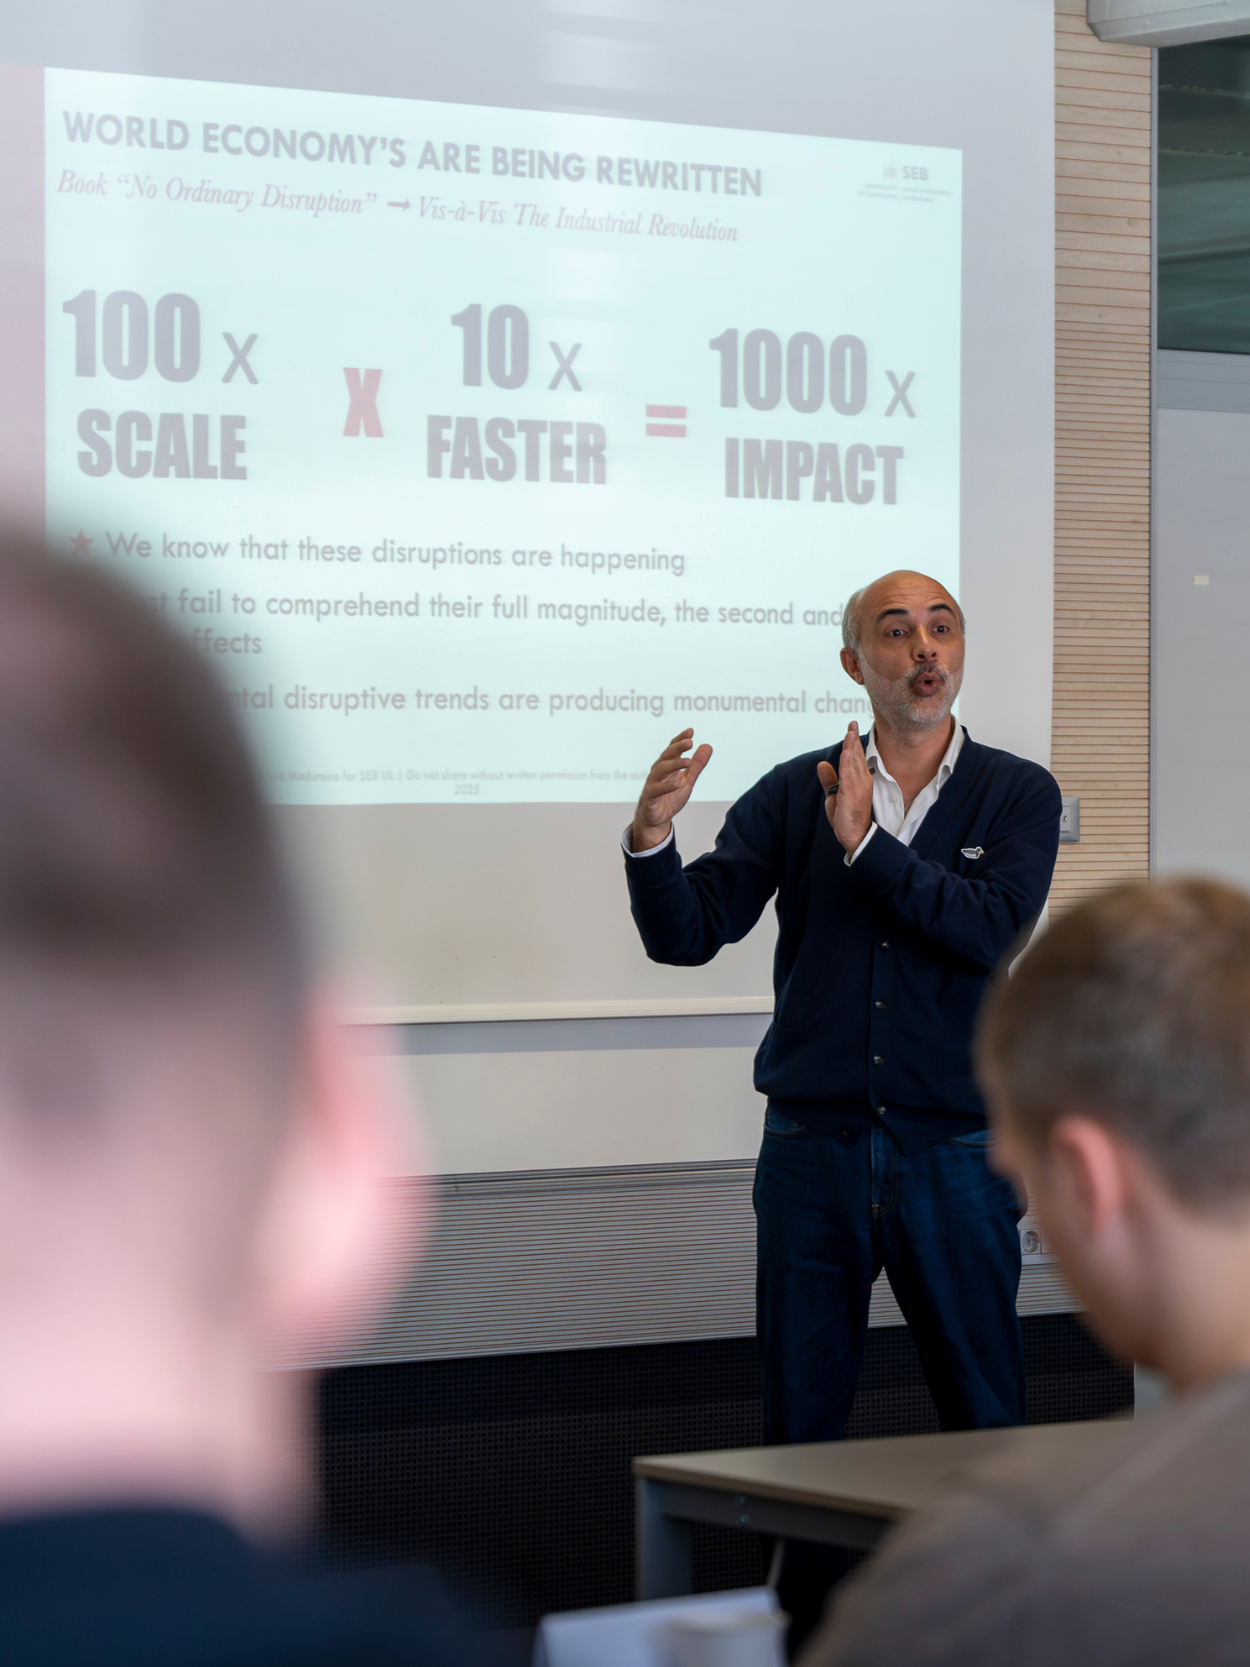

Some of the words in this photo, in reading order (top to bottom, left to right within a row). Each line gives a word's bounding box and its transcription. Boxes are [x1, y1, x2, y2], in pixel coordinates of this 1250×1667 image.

[63, 111, 190, 150] WORLD
[417, 141, 480, 174] ARE
[492, 146, 586, 182] BEING
[597, 156, 762, 197] REWRITTEN
[902, 166, 929, 181] SEB
[56, 169, 108, 196] Book
[166, 177, 254, 213] Ordinary
[419, 195, 506, 224] Vis-à-Vis
[513, 203, 549, 227] The
[554, 206, 642, 234] Industrial
[647, 214, 737, 242] Revolution
[62, 289, 201, 383] 100
[451, 304, 529, 390] 10
[709, 328, 867, 416] 1000
[77, 408, 247, 480] SCALE
[427, 415, 606, 484] FASTER
[725, 438, 904, 505] IMPACT
[106, 532, 152, 558] We
[163, 533, 229, 559] know
[239, 534, 289, 560] that
[298, 536, 362, 562] these
[372, 538, 502, 570] disruptions
[512, 550, 552, 567] are
[561, 543, 685, 577] happening
[178, 588, 221, 613] fail
[231, 593, 256, 614] to
[266, 592, 419, 622] comprehend
[429, 593, 483, 618] their
[492, 594, 527, 619] full
[538, 598, 666, 627] magnitude,
[675, 599, 710, 623] the
[718, 602, 793, 624] second
[803, 604, 844, 626] and
[193, 628, 262, 654] ffects
[284, 685, 407, 716] disruptive
[415, 686, 489, 710] trends
[499, 694, 540, 710] are
[550, 687, 664, 718] producing
[674, 690, 806, 713] monumental
[342, 769, 356, 782] for
[359, 770, 378, 782] SEB
[381, 770, 395, 781] UL
[406, 769, 421, 781] Do
[423, 771, 439, 781] not
[441, 769, 468, 781] share
[469, 769, 504, 781] without
[505, 769, 538, 781] written
[540, 769, 588, 783] permission
[590, 769, 612, 781] from
[613, 769, 628, 781] the
[454, 784, 480, 795] 2025
